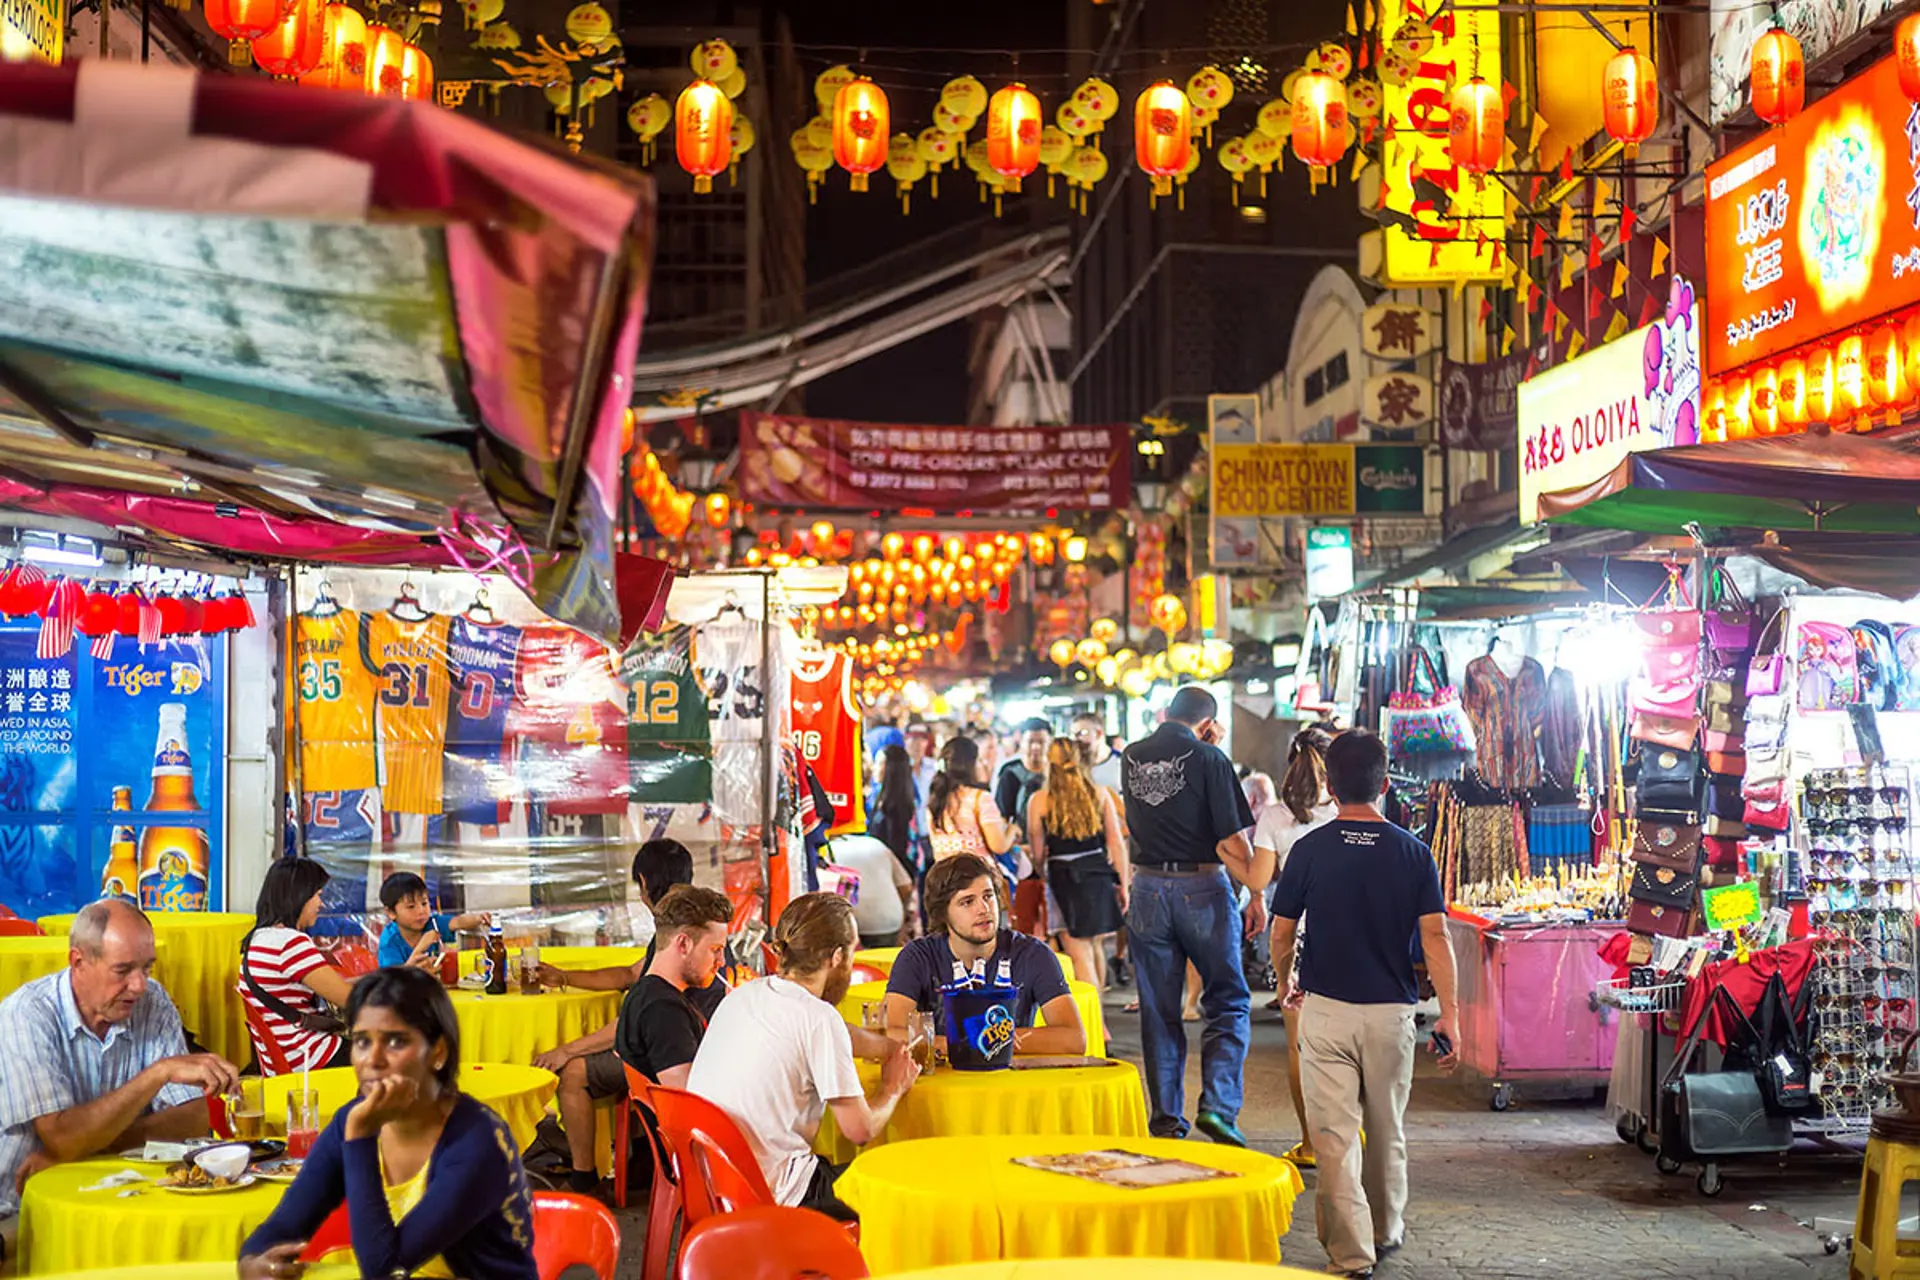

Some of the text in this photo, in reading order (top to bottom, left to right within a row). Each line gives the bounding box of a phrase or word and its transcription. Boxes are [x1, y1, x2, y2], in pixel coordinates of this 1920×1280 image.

[1572, 394, 1640, 455] OLOIYA
[1217, 458, 1348, 486] CHINATOWN
[1217, 486, 1349, 511] FOOD CENTRE
[383, 643, 435, 660] MILLER
[0, 668, 72, 690] 洲酿造
[103, 663, 166, 696] Tiger
[299, 659, 342, 702] 35
[380, 661, 431, 708] 31
[0, 692, 72, 713] 誉全球
[631, 680, 679, 724] 12
[28, 717, 40, 729] IN
[22, 730, 73, 742] AROUND
[4, 743, 26, 755] THE
[161, 752, 185, 765] Tiger
[983, 1018, 1013, 1043] Tige
